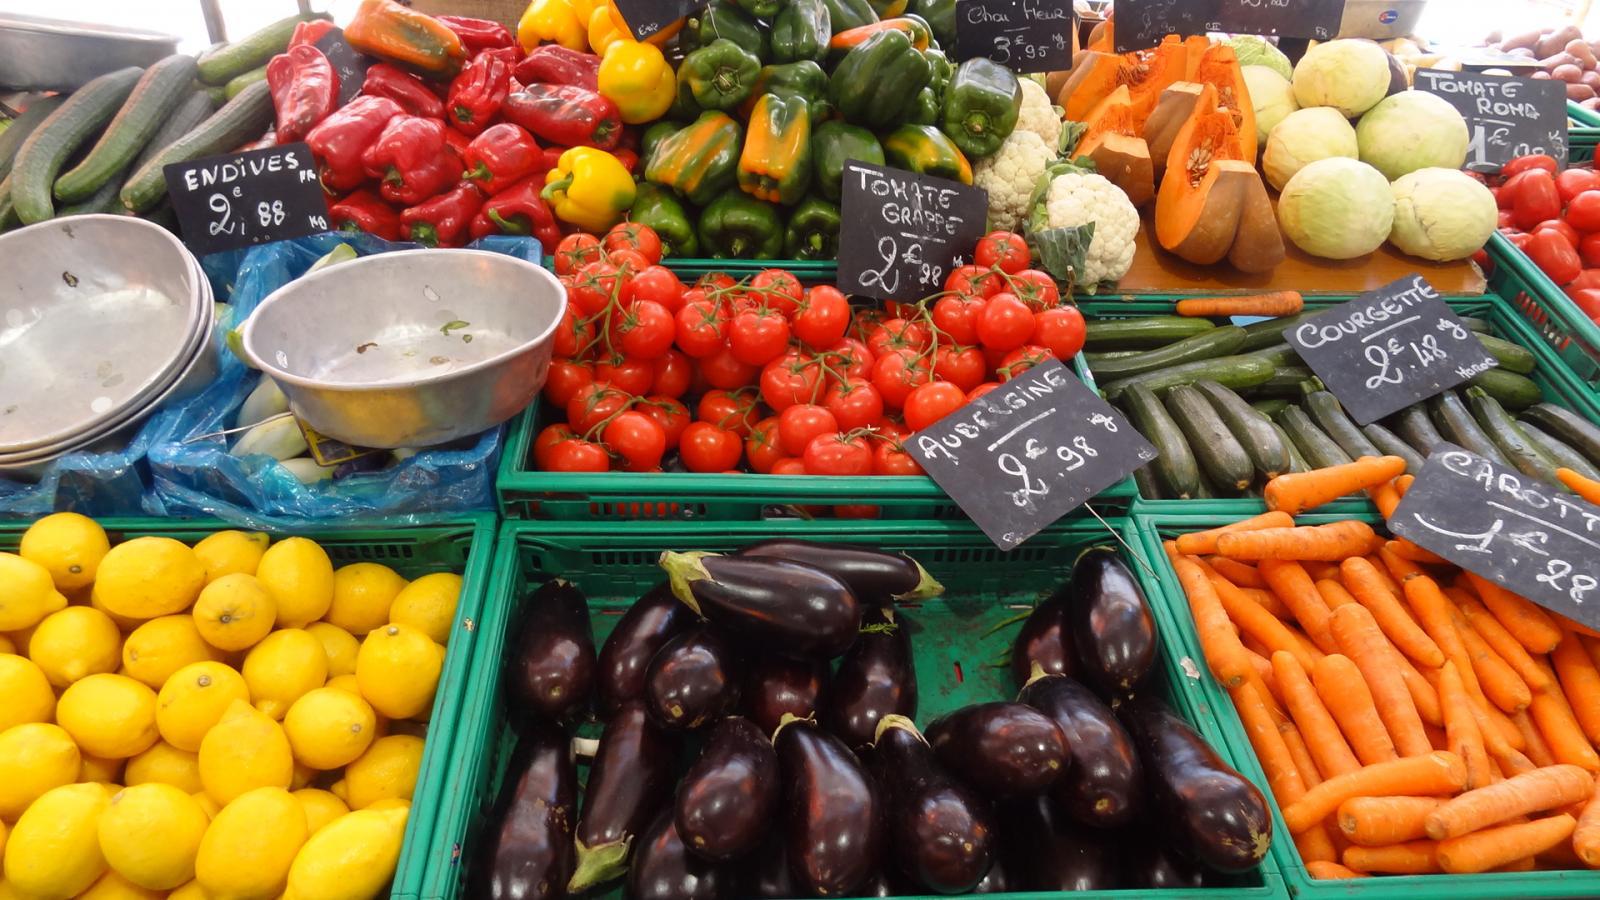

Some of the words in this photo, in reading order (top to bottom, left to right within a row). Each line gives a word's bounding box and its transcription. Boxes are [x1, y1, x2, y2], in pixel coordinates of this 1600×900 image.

[1418, 71, 1523, 98] TOMATE
[1476, 98, 1541, 120] ROMA
[849, 165, 959, 210] TOMATE
[882, 202, 963, 235] GRAPPE
[1296, 276, 1440, 349] COURGETTE
